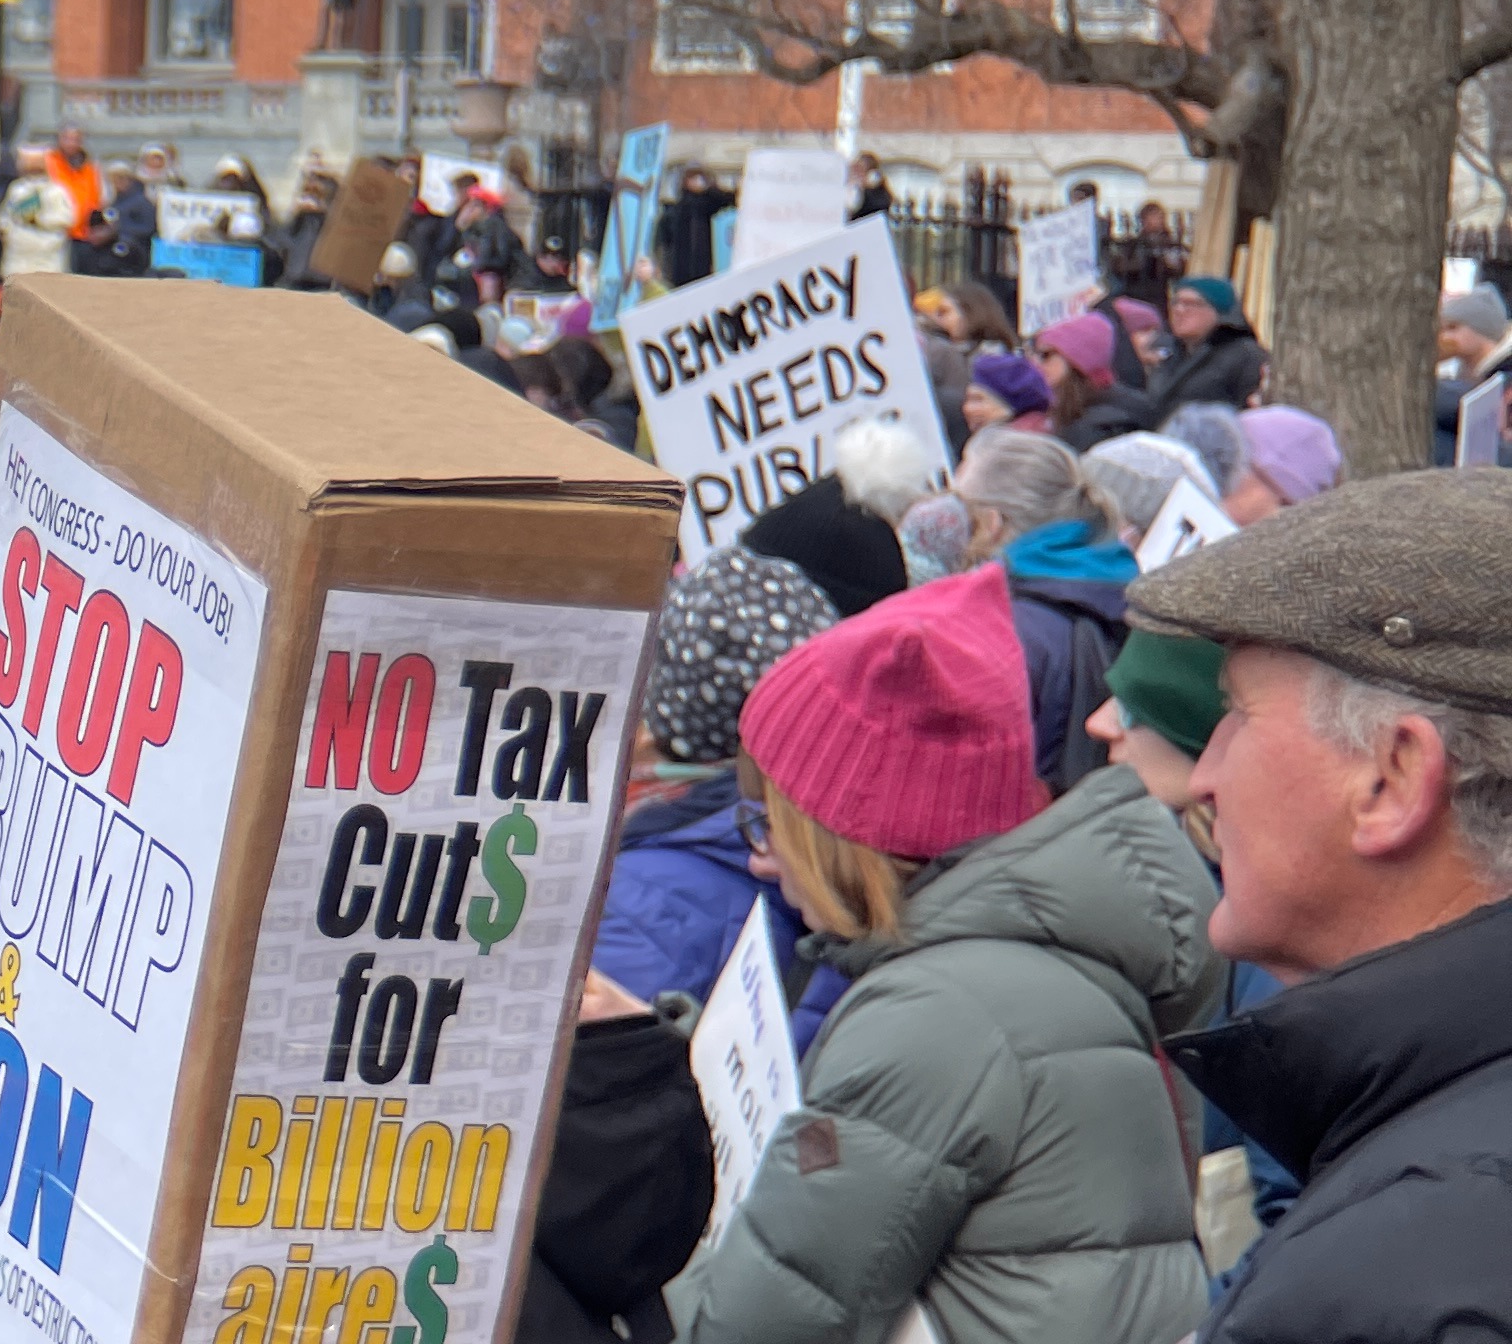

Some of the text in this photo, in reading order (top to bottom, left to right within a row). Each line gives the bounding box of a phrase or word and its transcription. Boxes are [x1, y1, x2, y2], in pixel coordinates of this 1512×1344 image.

[641, 255, 859, 396] DEMOCRACY
[706, 330, 888, 453] NEEDS
[5, 443, 32, 504] HEY
[28, 476, 105, 555] CONGRESS
[113, 524, 145, 573] DO
[147, 537, 195, 606] YOUR
[192, 573, 235, 645] JOB!
[304, 650, 607, 804] NO Tax
[316, 803, 538, 956] Cut$
[323, 952, 465, 1085] for
[211, 1093, 511, 1233] Billion
[7, 1263, 27, 1309] OF
